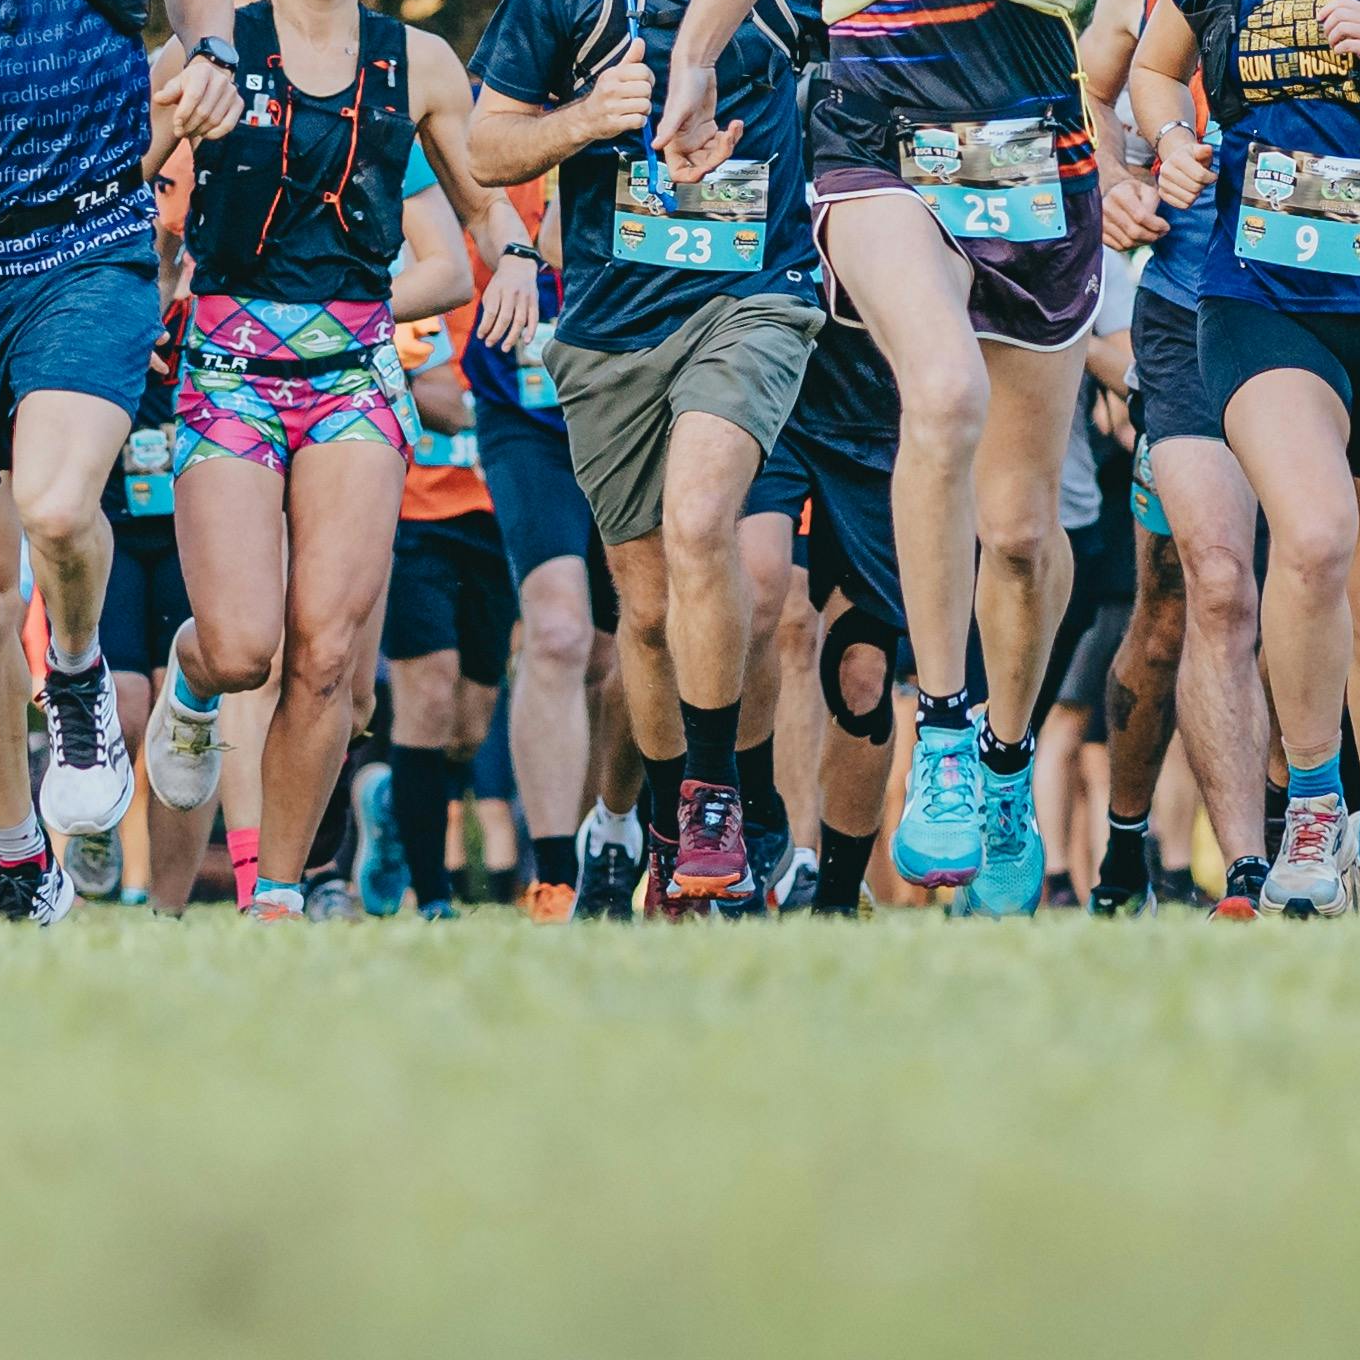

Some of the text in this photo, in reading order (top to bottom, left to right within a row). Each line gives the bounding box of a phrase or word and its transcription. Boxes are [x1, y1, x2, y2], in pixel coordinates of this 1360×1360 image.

[1238, 54, 1274, 82] RUN
[963, 194, 1011, 233] 25
[665, 225, 713, 264] 23
[1295, 225, 1319, 262] 9
[202, 353, 249, 371] TLR
